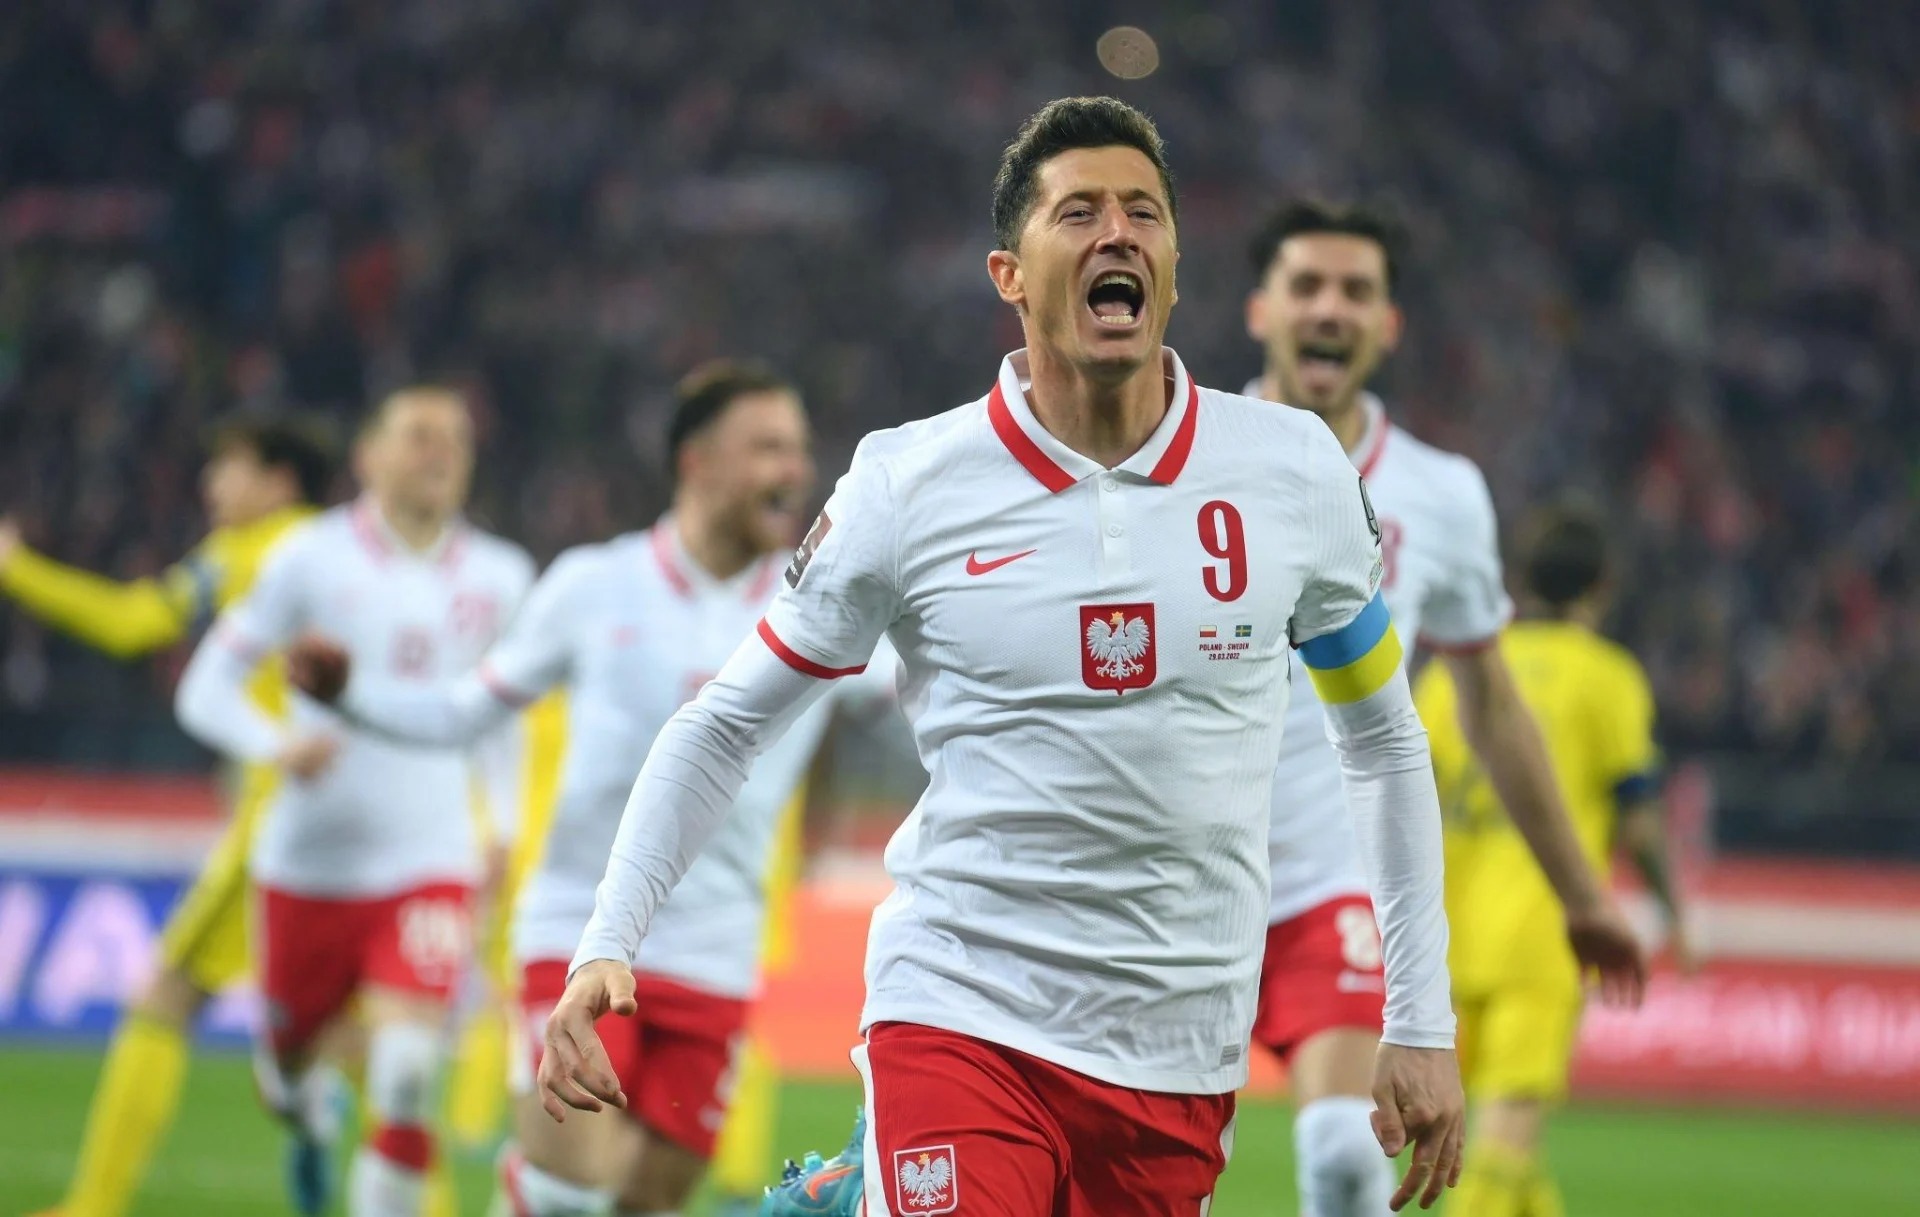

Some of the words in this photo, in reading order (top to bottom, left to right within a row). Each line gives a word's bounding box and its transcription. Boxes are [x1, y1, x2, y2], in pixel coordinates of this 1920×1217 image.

[1197, 500, 1248, 602] 9
[1199, 643, 1223, 651] POLAND
[1227, 642, 1250, 651] SWEDEN
[1208, 652, 1240, 660] 29.03.2022
